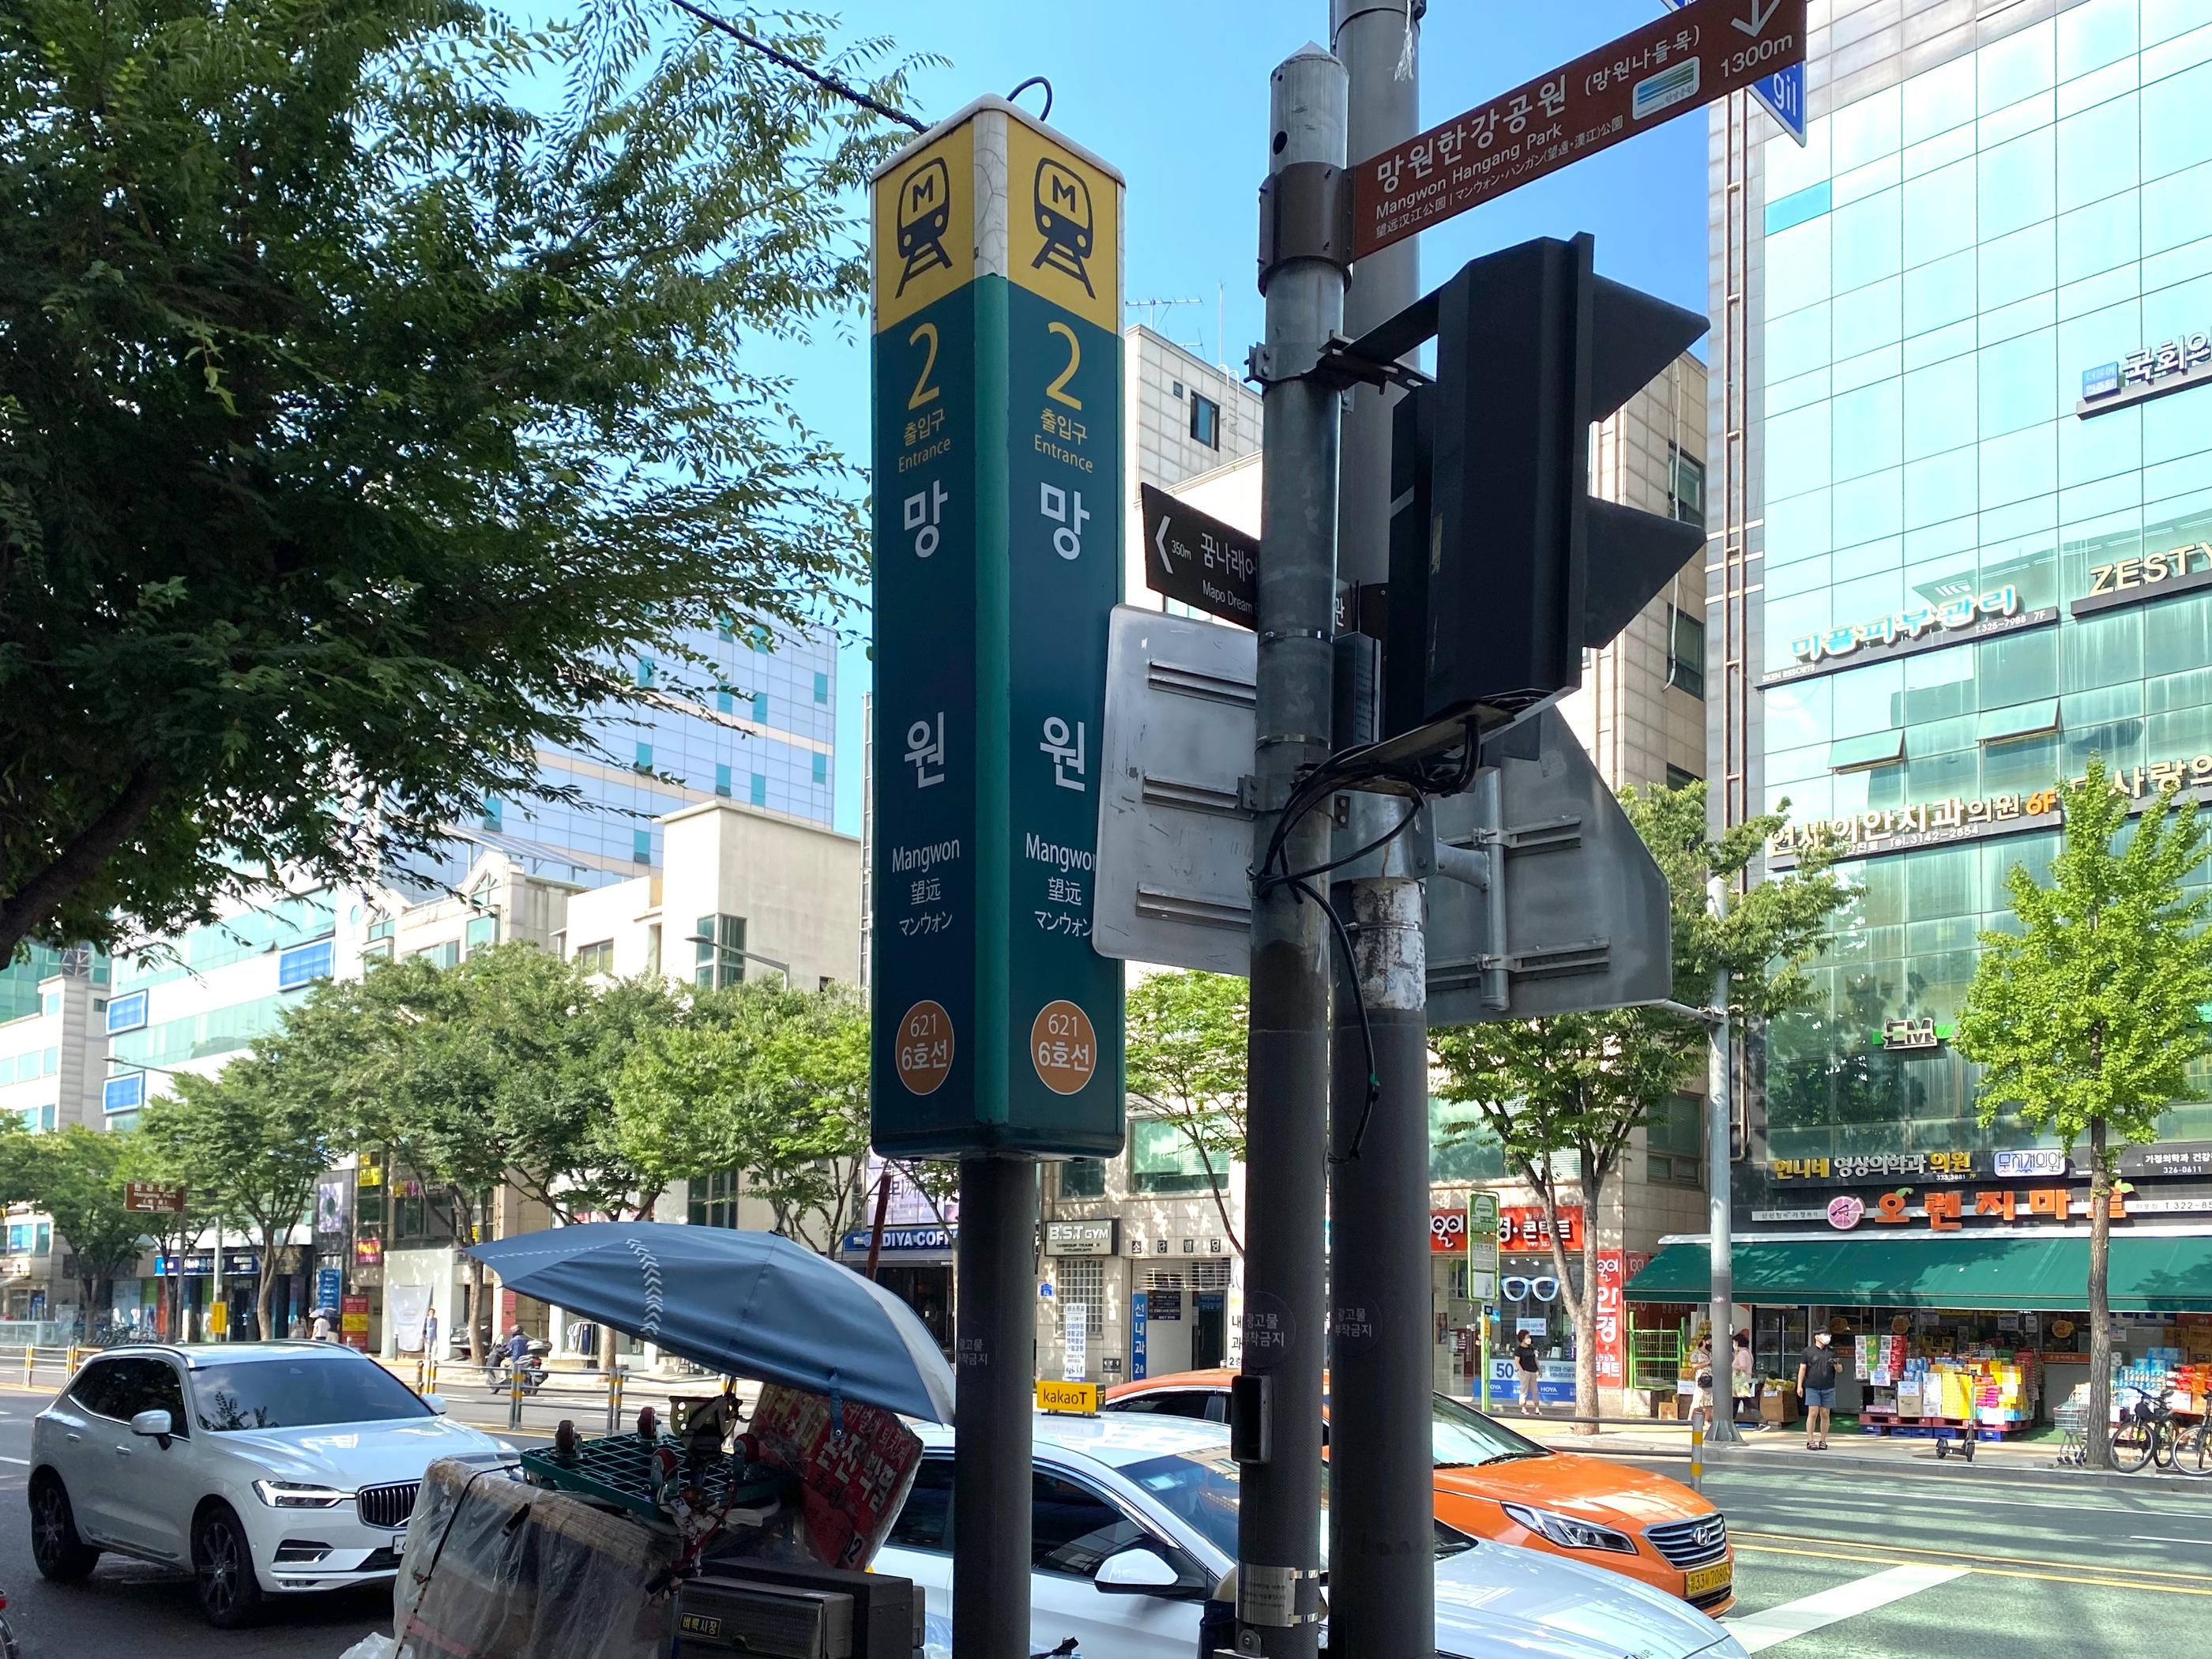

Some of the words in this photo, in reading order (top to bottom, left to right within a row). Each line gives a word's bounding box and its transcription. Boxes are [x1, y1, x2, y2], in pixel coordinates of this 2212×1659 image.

[1721, 35, 1793, 77] 1300m
[1377, 74, 1566, 193] 망원한강공원
[1585, 25, 1700, 96] (망원나들목)
[1376, 179, 1446, 220] Mangwon
[1452, 144, 1521, 185] Hangang
[1526, 122, 1563, 150] Park
[912, 175, 934, 213] M
[1052, 175, 1075, 213] M
[908, 322, 939, 411] 2
[1045, 322, 1082, 411] 2
[903, 408, 946, 446] 출입구
[1040, 408, 1088, 446] 출입구
[898, 437, 951, 472] Entrance
[1034, 434, 1093, 473] Entrance
[1171, 540, 1192, 561] 350m
[1202, 579, 1225, 604] Mapo
[1227, 590, 1253, 613] Dream
[2026, 791, 2057, 816] 6F
[892, 839, 960, 873] Mangwon
[911, 878, 941, 905] 望远
[1048, 877, 1082, 905] 望远
[910, 1014, 937, 1037] 621
[1048, 1014, 1078, 1036] 621
[901, 1039, 947, 1070] 6호선
[1038, 1041, 1089, 1072] 6호선
[1774, 1157, 1830, 1180] 언니네
[1834, 1153, 1928, 1178] 영상의학과
[1930, 1150, 1972, 1173] 의원
[2145, 1153, 2189, 1164] 가정의학과
[2163, 1165, 2203, 1174] 326-0611
[875, 1232, 913, 1247] DIYA
[1085, 1228, 1108, 1239] GYM
[1134, 1303, 1146, 1356] 선내과
[1337, 1307, 1367, 1322] 광고물
[1043, 1389, 1088, 1406] kakaoT
[683, 1616, 719, 1635] 벼룩시장
